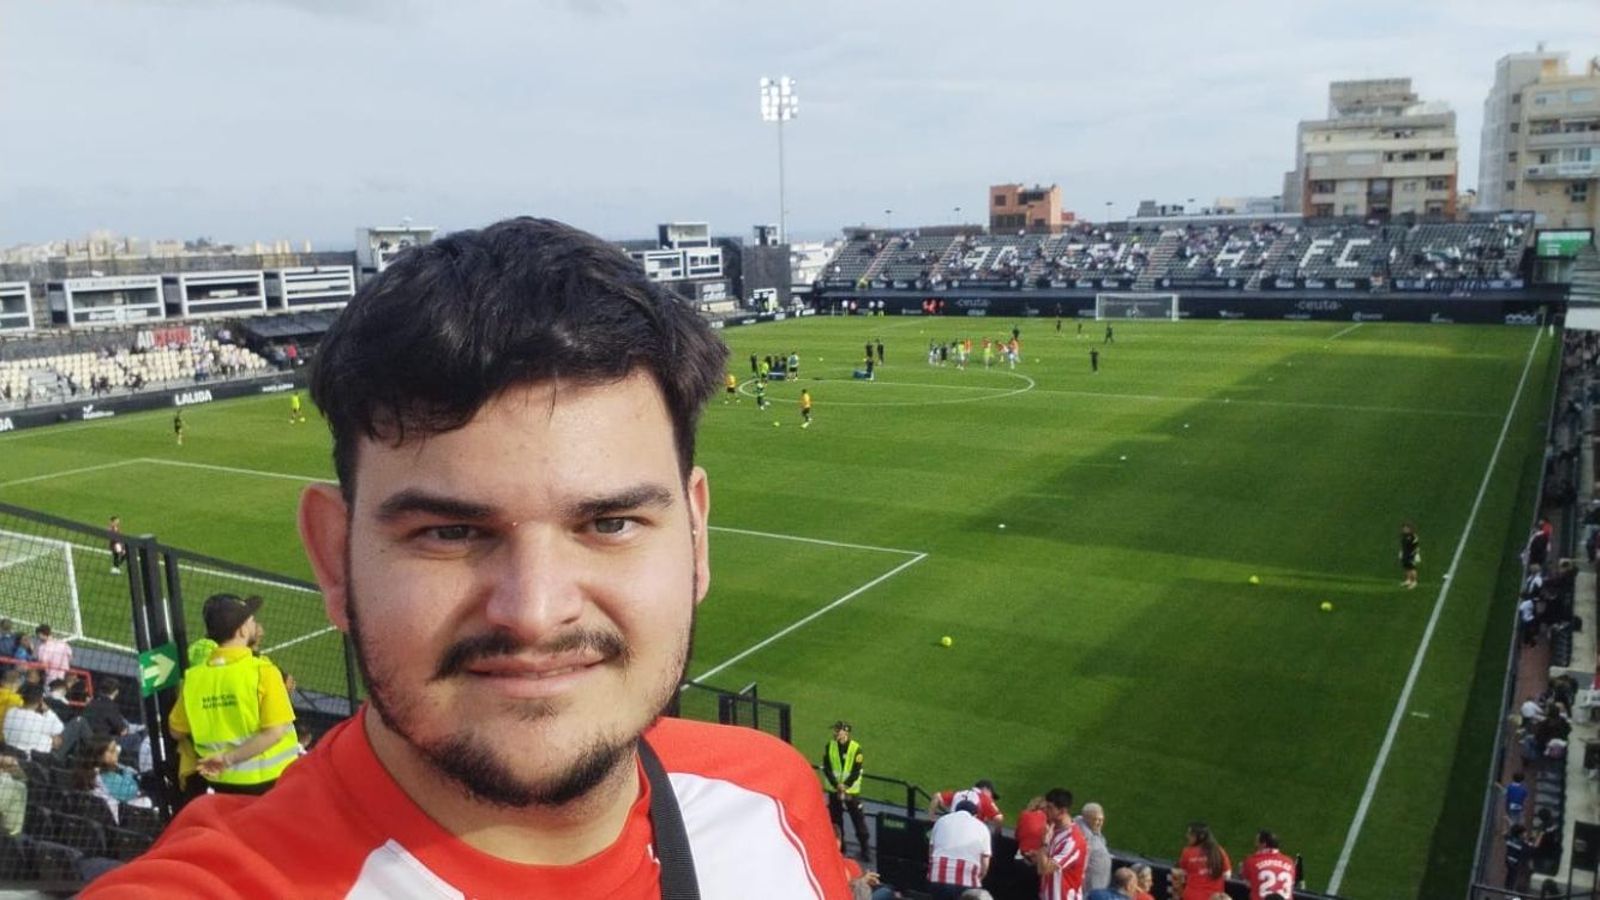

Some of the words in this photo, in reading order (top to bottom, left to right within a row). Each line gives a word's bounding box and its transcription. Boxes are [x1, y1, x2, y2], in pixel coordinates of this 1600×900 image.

[1300, 238, 1371, 268] FC
[174, 389, 213, 406] LALIGA
[1258, 869, 1292, 899] 23
